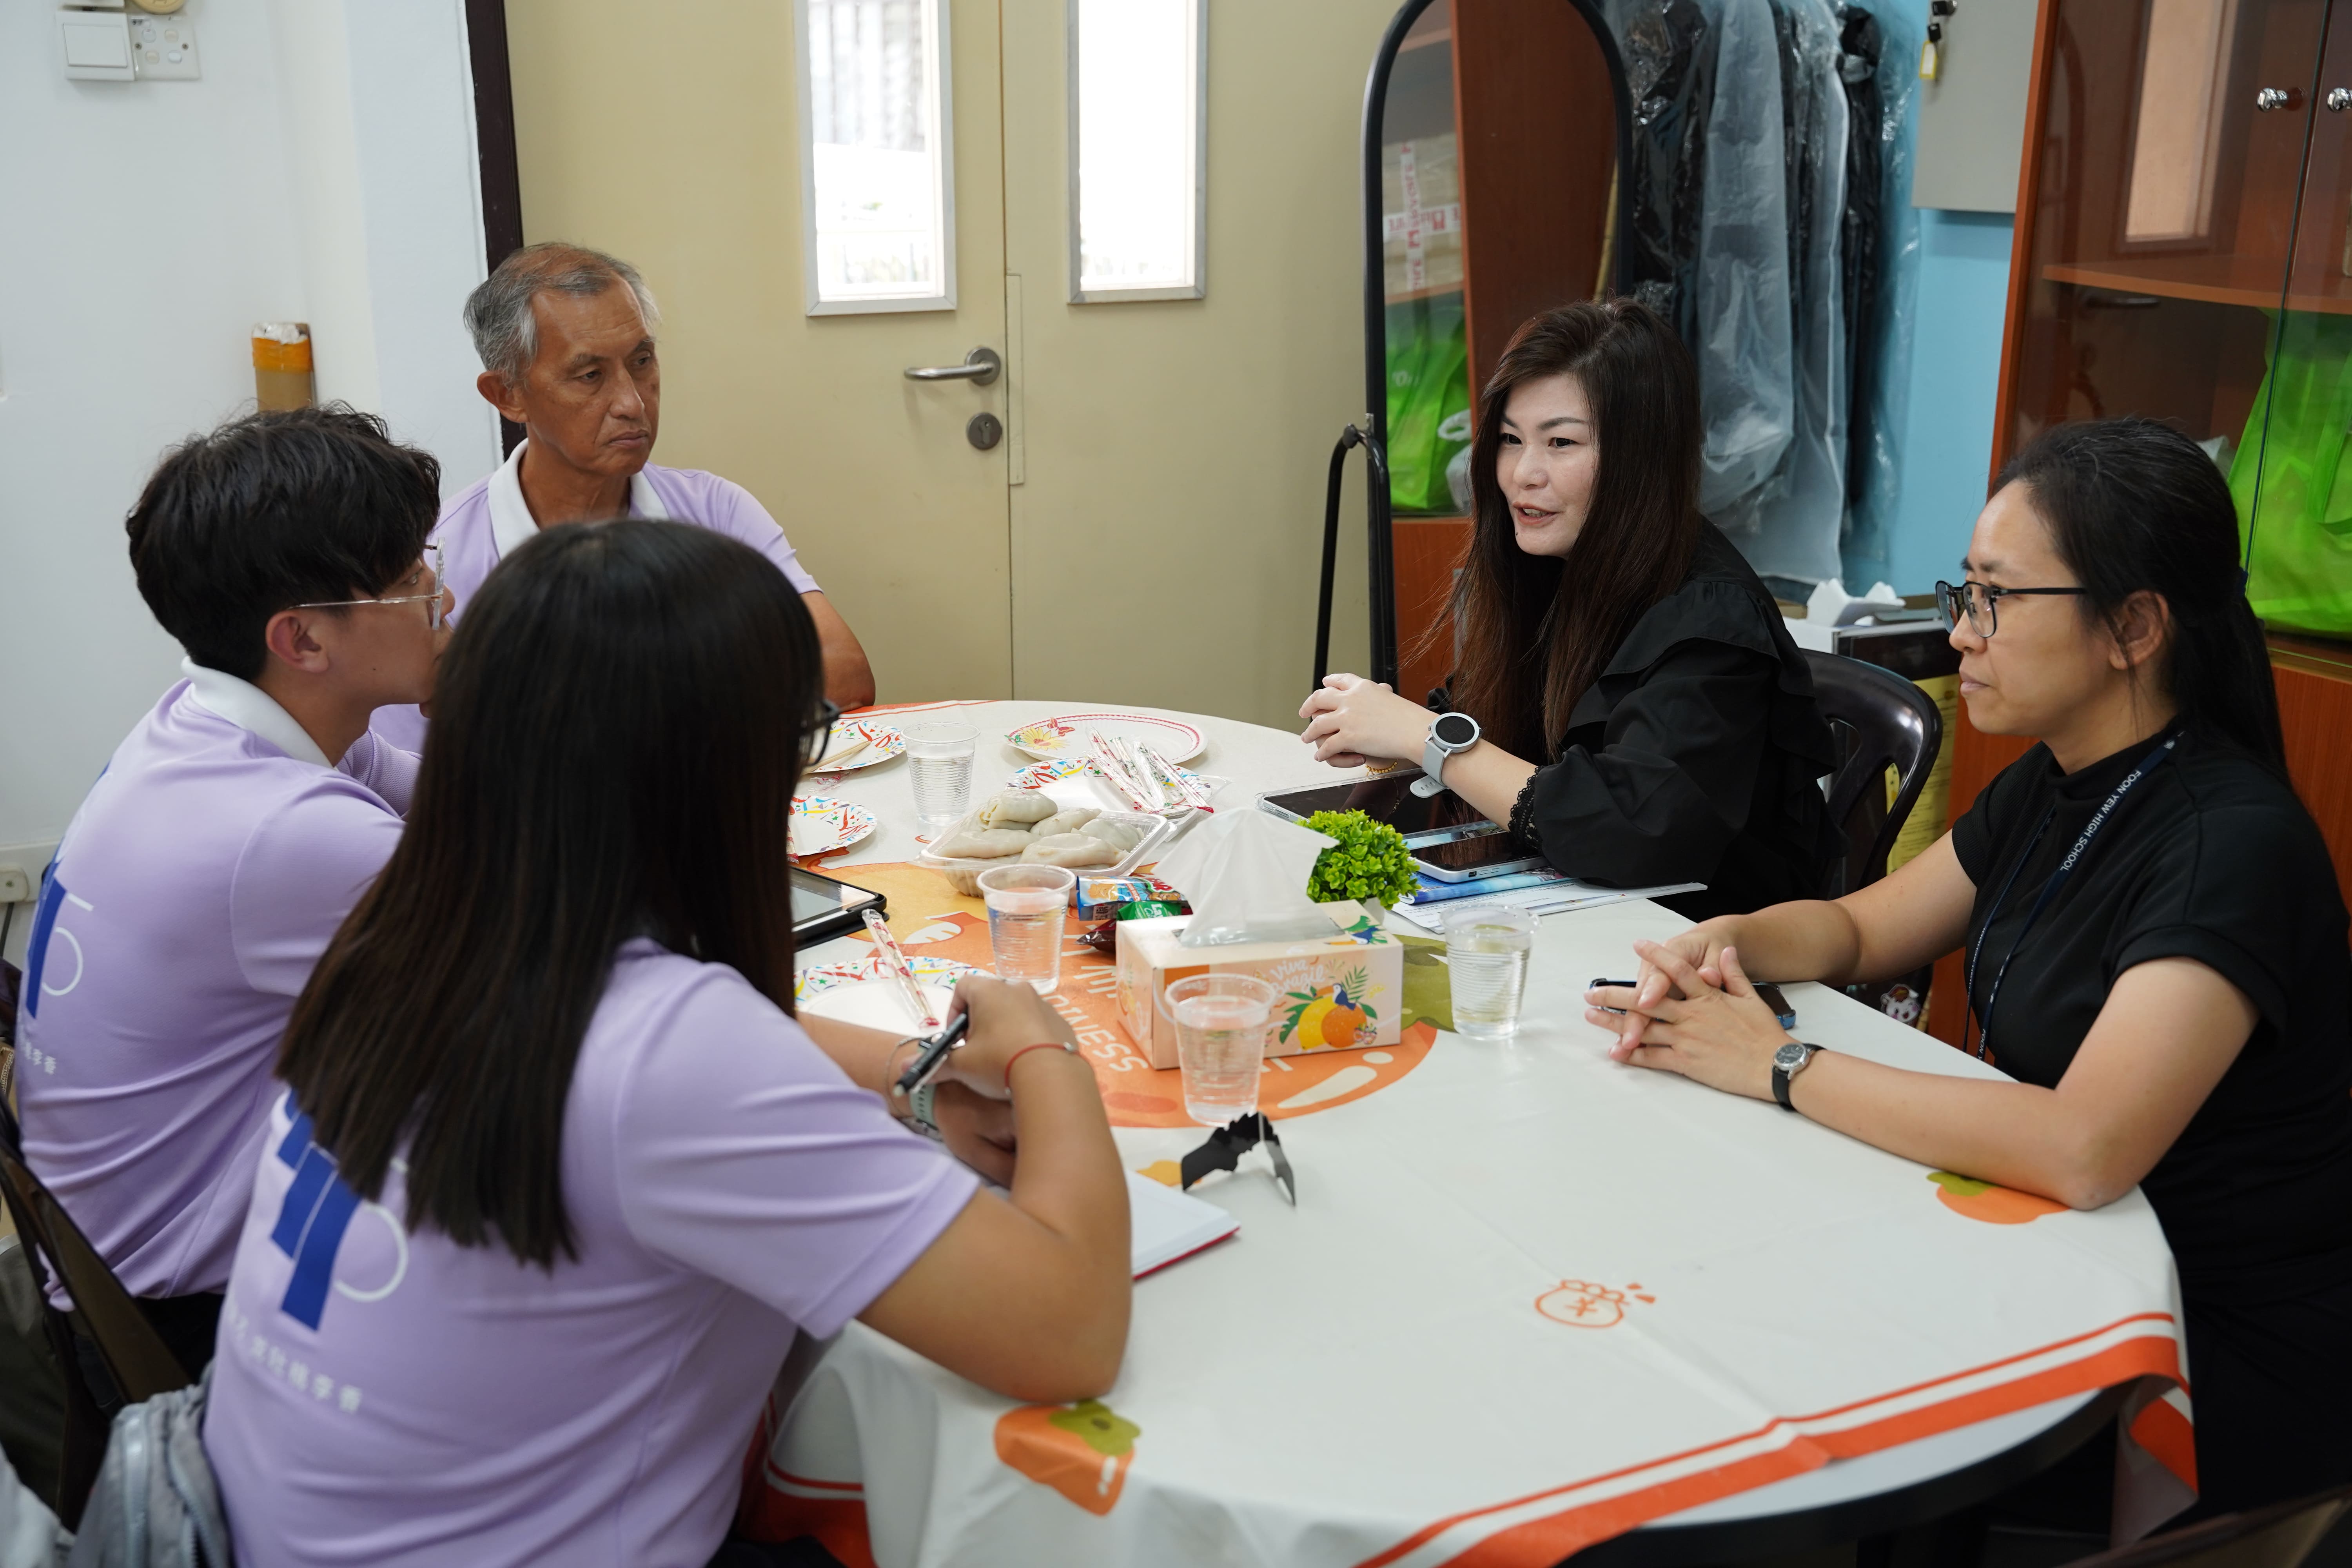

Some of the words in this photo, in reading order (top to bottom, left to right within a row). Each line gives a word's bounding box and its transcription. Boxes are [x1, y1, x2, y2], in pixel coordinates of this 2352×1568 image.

[2116, 769, 2142, 794] FOON
[2101, 794, 2120, 814] YEW
[2084, 813, 2104, 837] HIGH
[2060, 837, 2088, 871] SCHOOL
